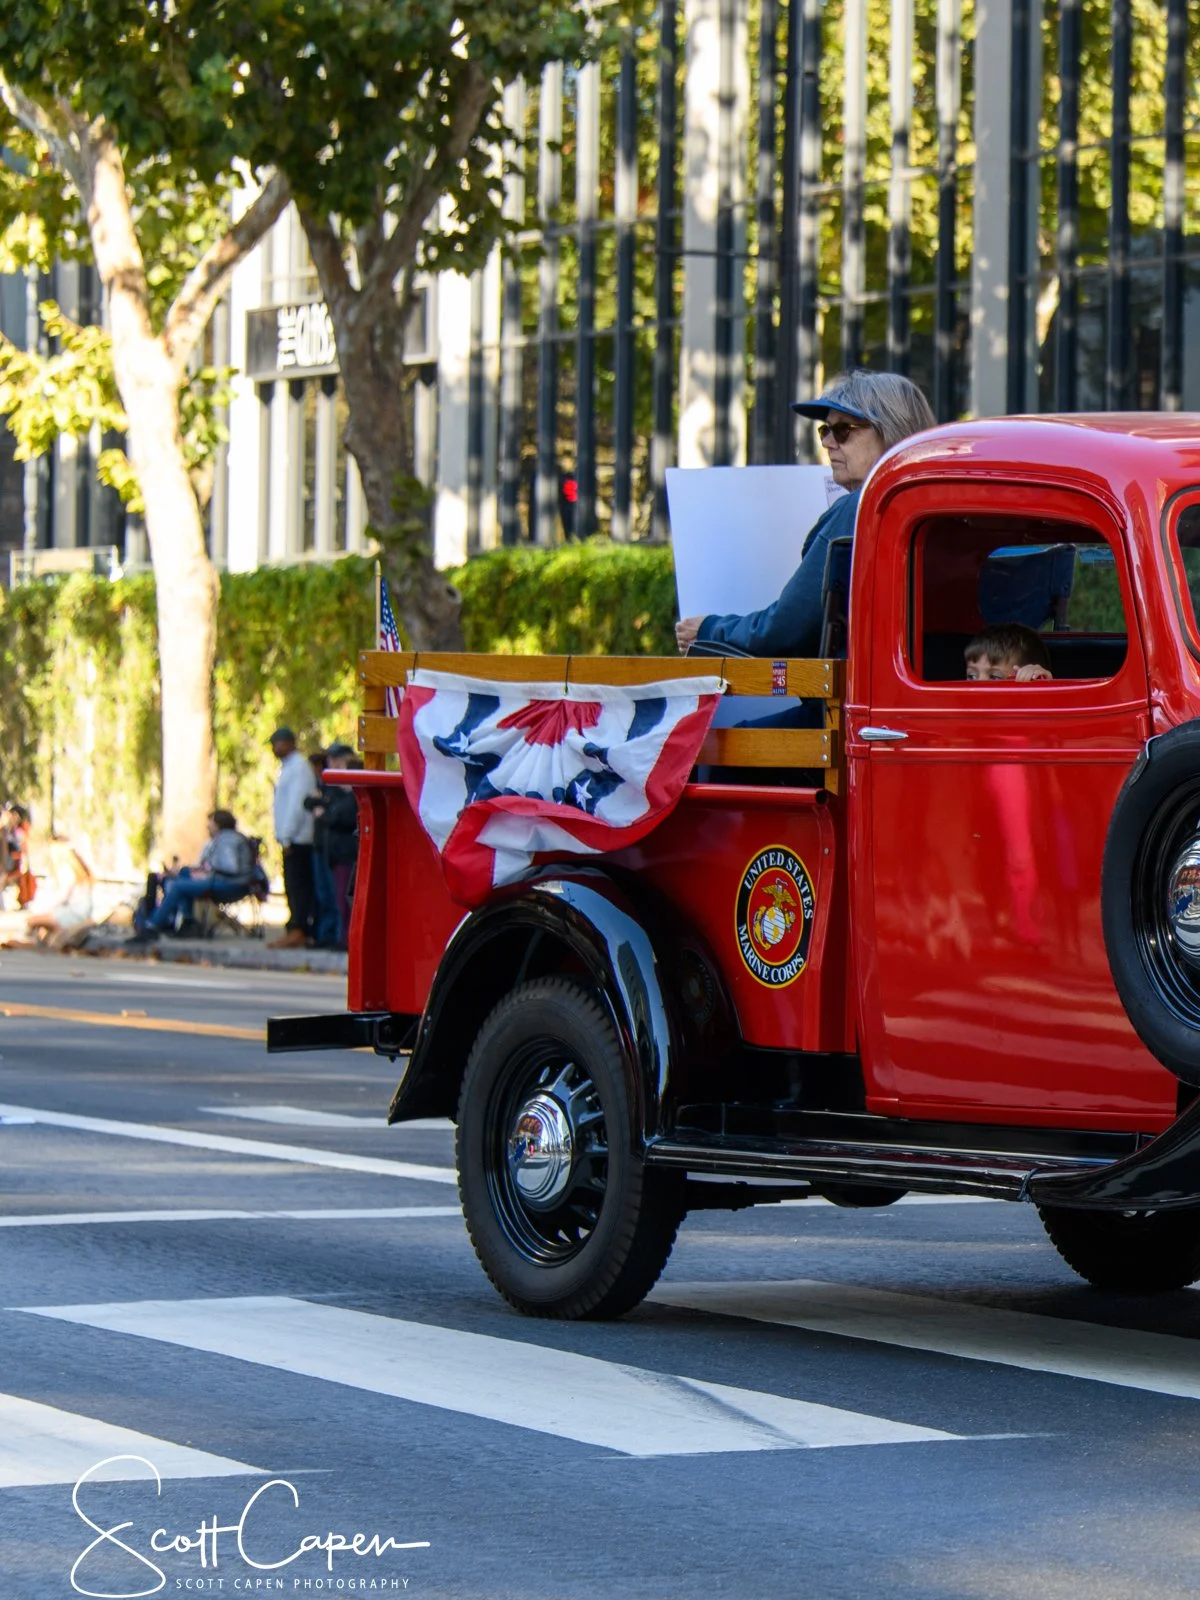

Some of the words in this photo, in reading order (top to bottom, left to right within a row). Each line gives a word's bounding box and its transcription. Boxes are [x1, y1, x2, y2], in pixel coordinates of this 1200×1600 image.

[744, 852, 784, 890] UNITED
[786, 857, 814, 920] STATES
[738, 923, 770, 981] MARINE
[771, 953, 805, 983] CORPS
